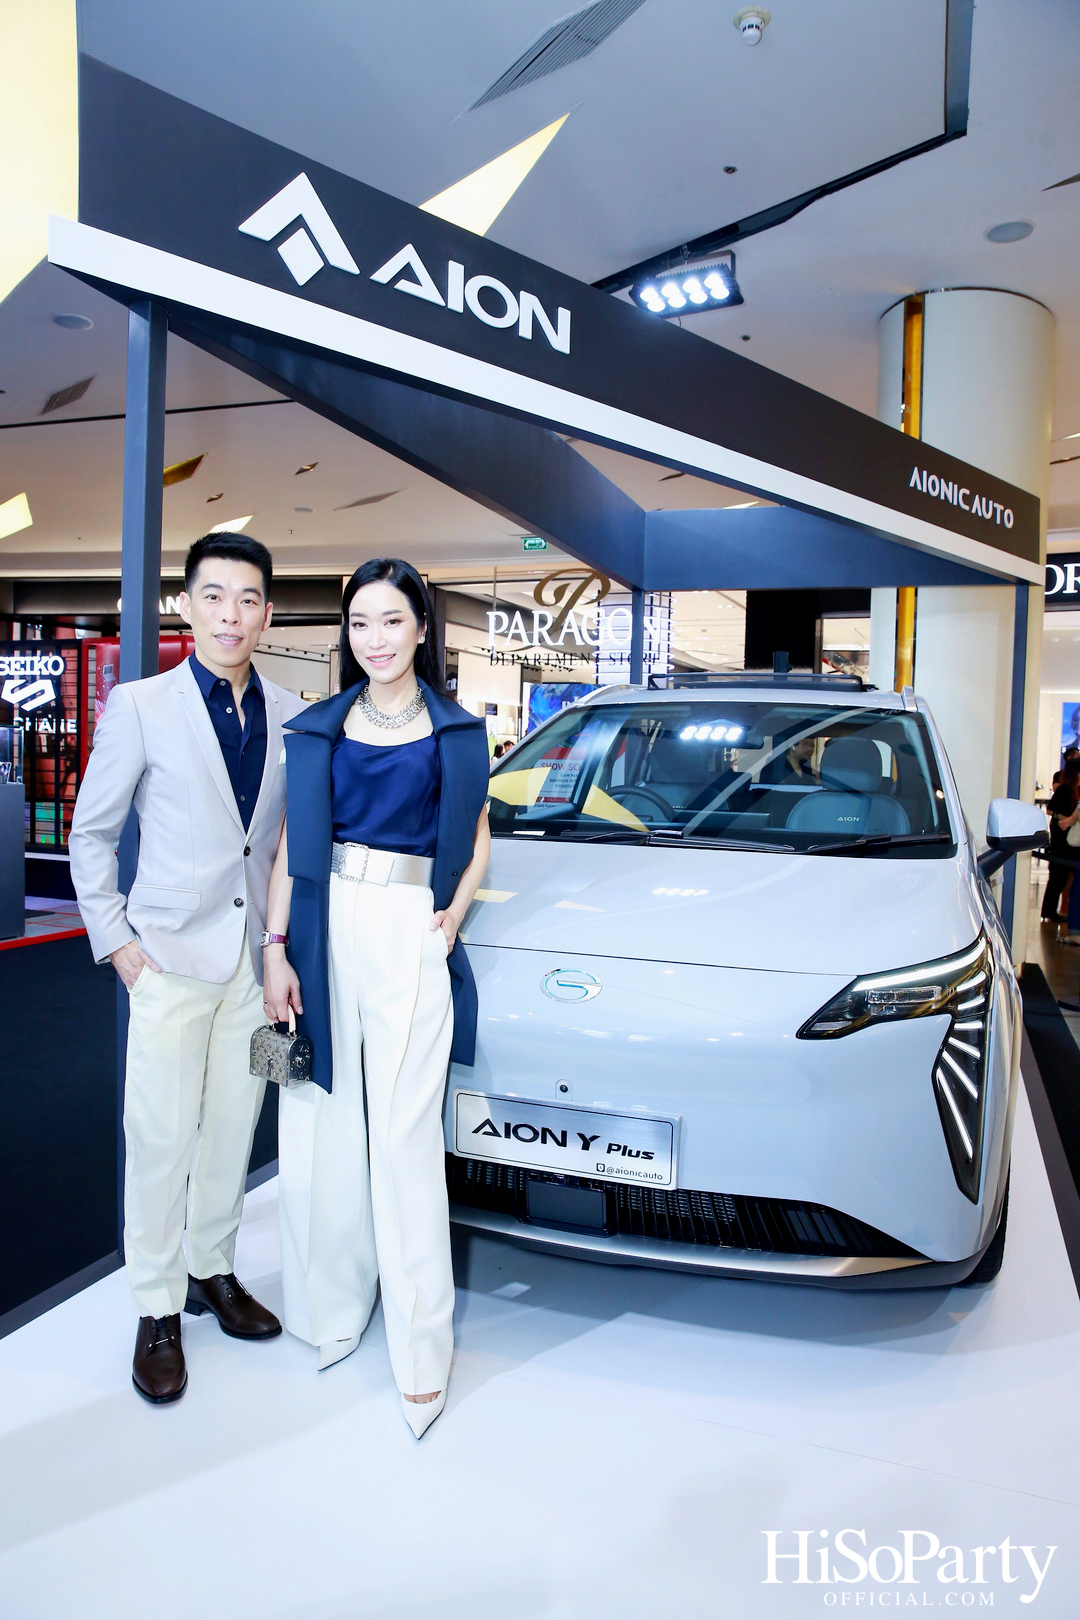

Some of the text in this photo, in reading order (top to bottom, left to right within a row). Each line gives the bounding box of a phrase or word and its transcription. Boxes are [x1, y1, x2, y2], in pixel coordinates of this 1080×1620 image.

[369, 243, 571, 355] AION
[486, 606, 664, 648] PARAGON
[0, 655, 65, 676] SEIKO
[472, 1118, 655, 1161] AION Y Plus
[606, 1166, 664, 1181] @aionicauto
